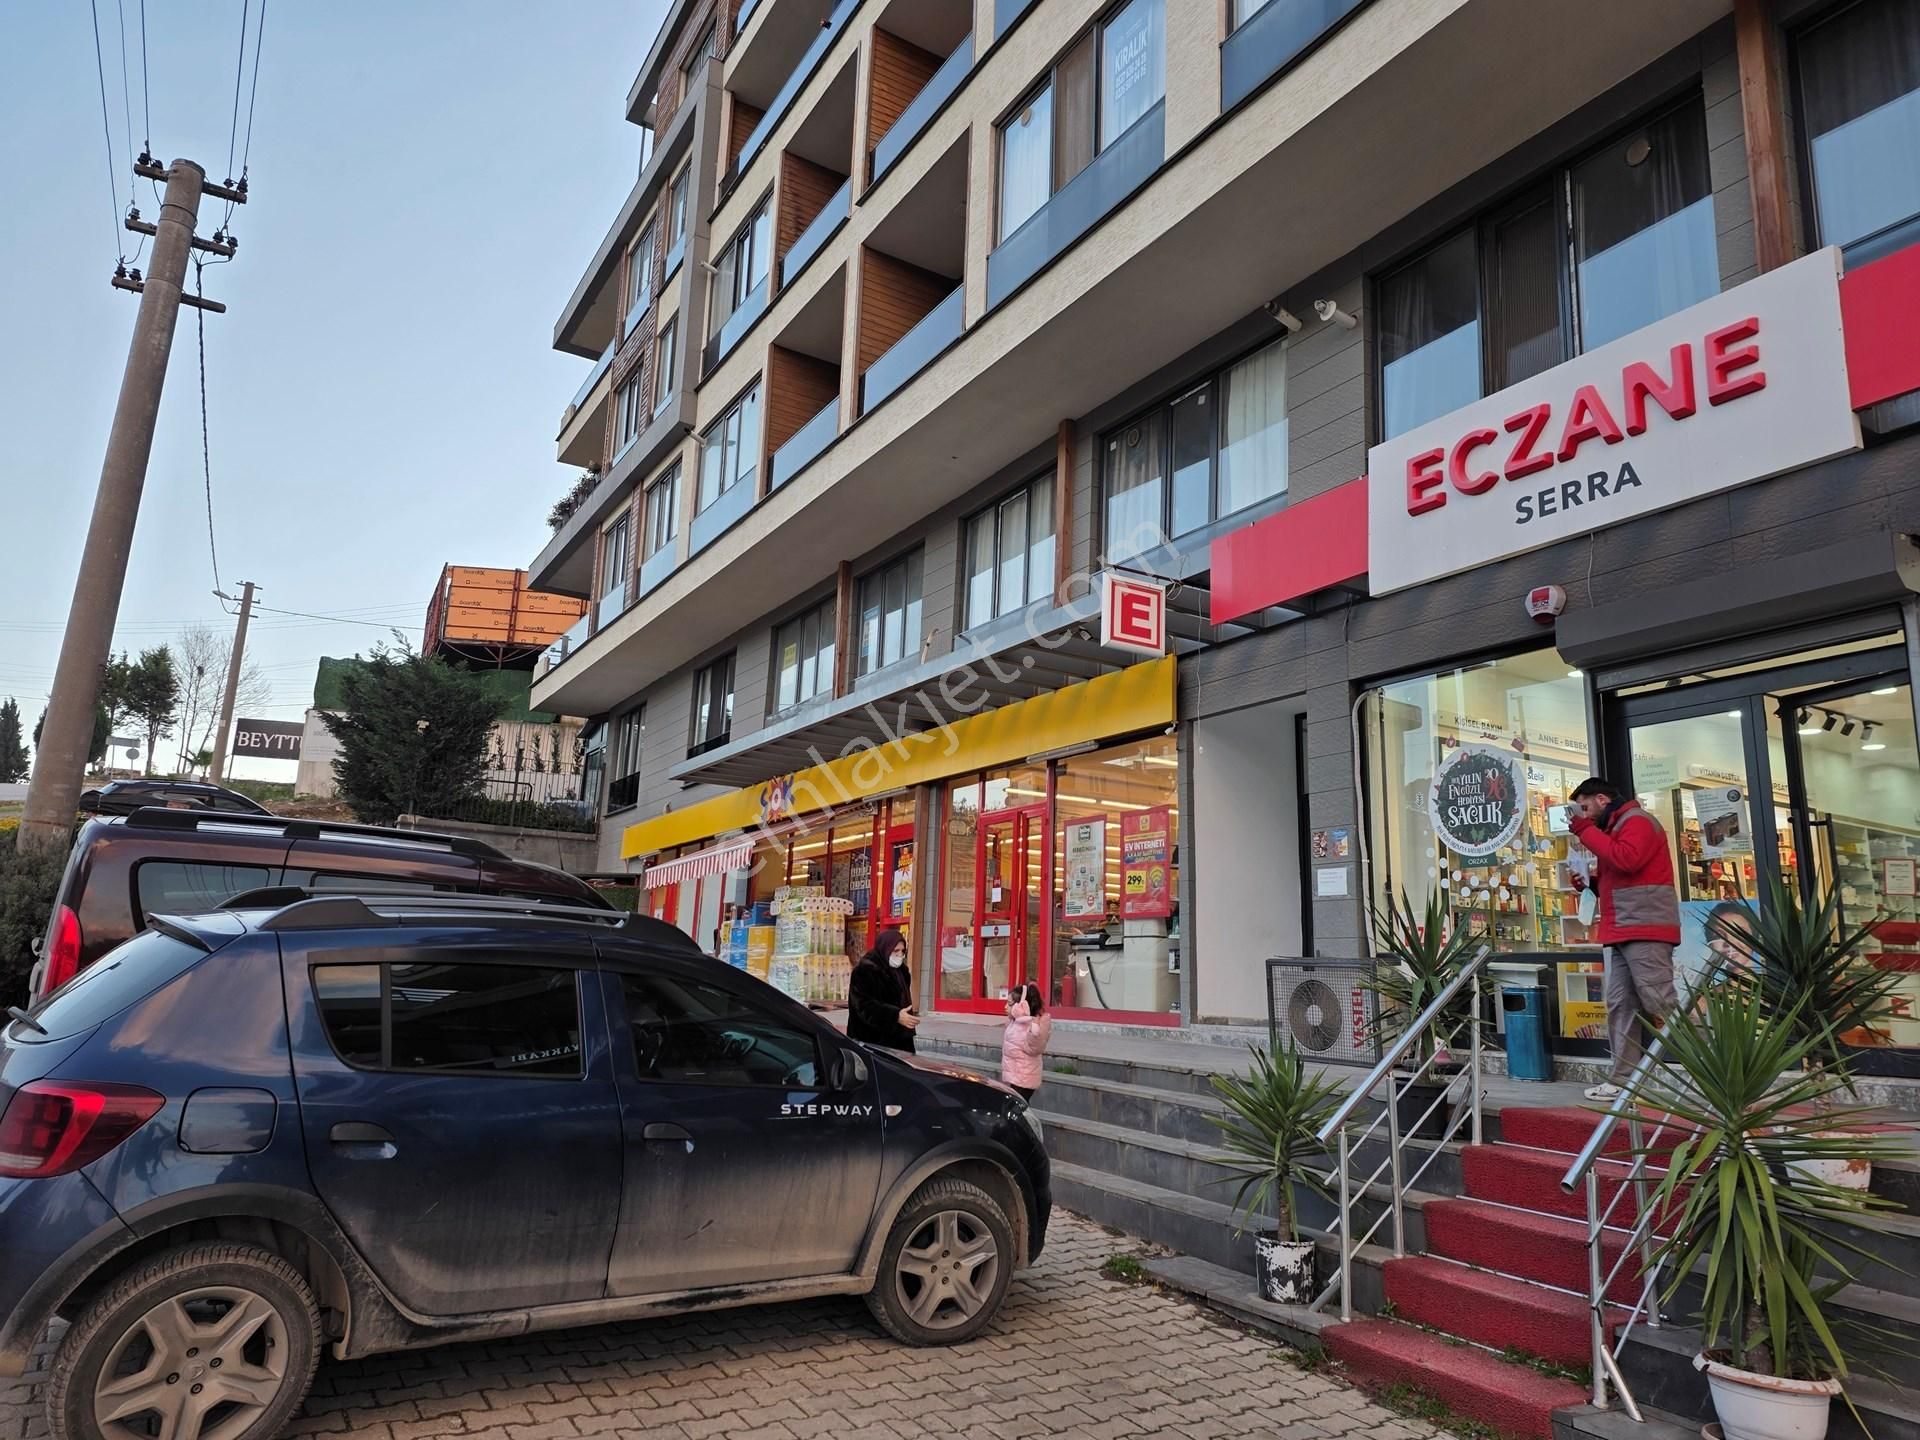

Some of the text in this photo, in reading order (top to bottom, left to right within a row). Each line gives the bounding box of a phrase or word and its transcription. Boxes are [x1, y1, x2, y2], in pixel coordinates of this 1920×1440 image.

[1406, 316, 1767, 517] ECZANE
[1515, 461, 1642, 525] SERRA
[1121, 593, 1152, 640] E
[237, 730, 303, 750] BEYTT
[1538, 733, 1559, 745] ANNE
[1564, 738, 1588, 750] BEBEK
[1460, 772, 1482, 786] YILIN
[1448, 784, 1480, 800] EN GÜZEL
[1448, 800, 1505, 828] SAĞLIK
[1124, 842, 1134, 852] EV
[1127, 876, 1142, 886] 299
[1352, 987, 1365, 1049] VESTEL
[781, 1104, 873, 1116] STEPWAY
